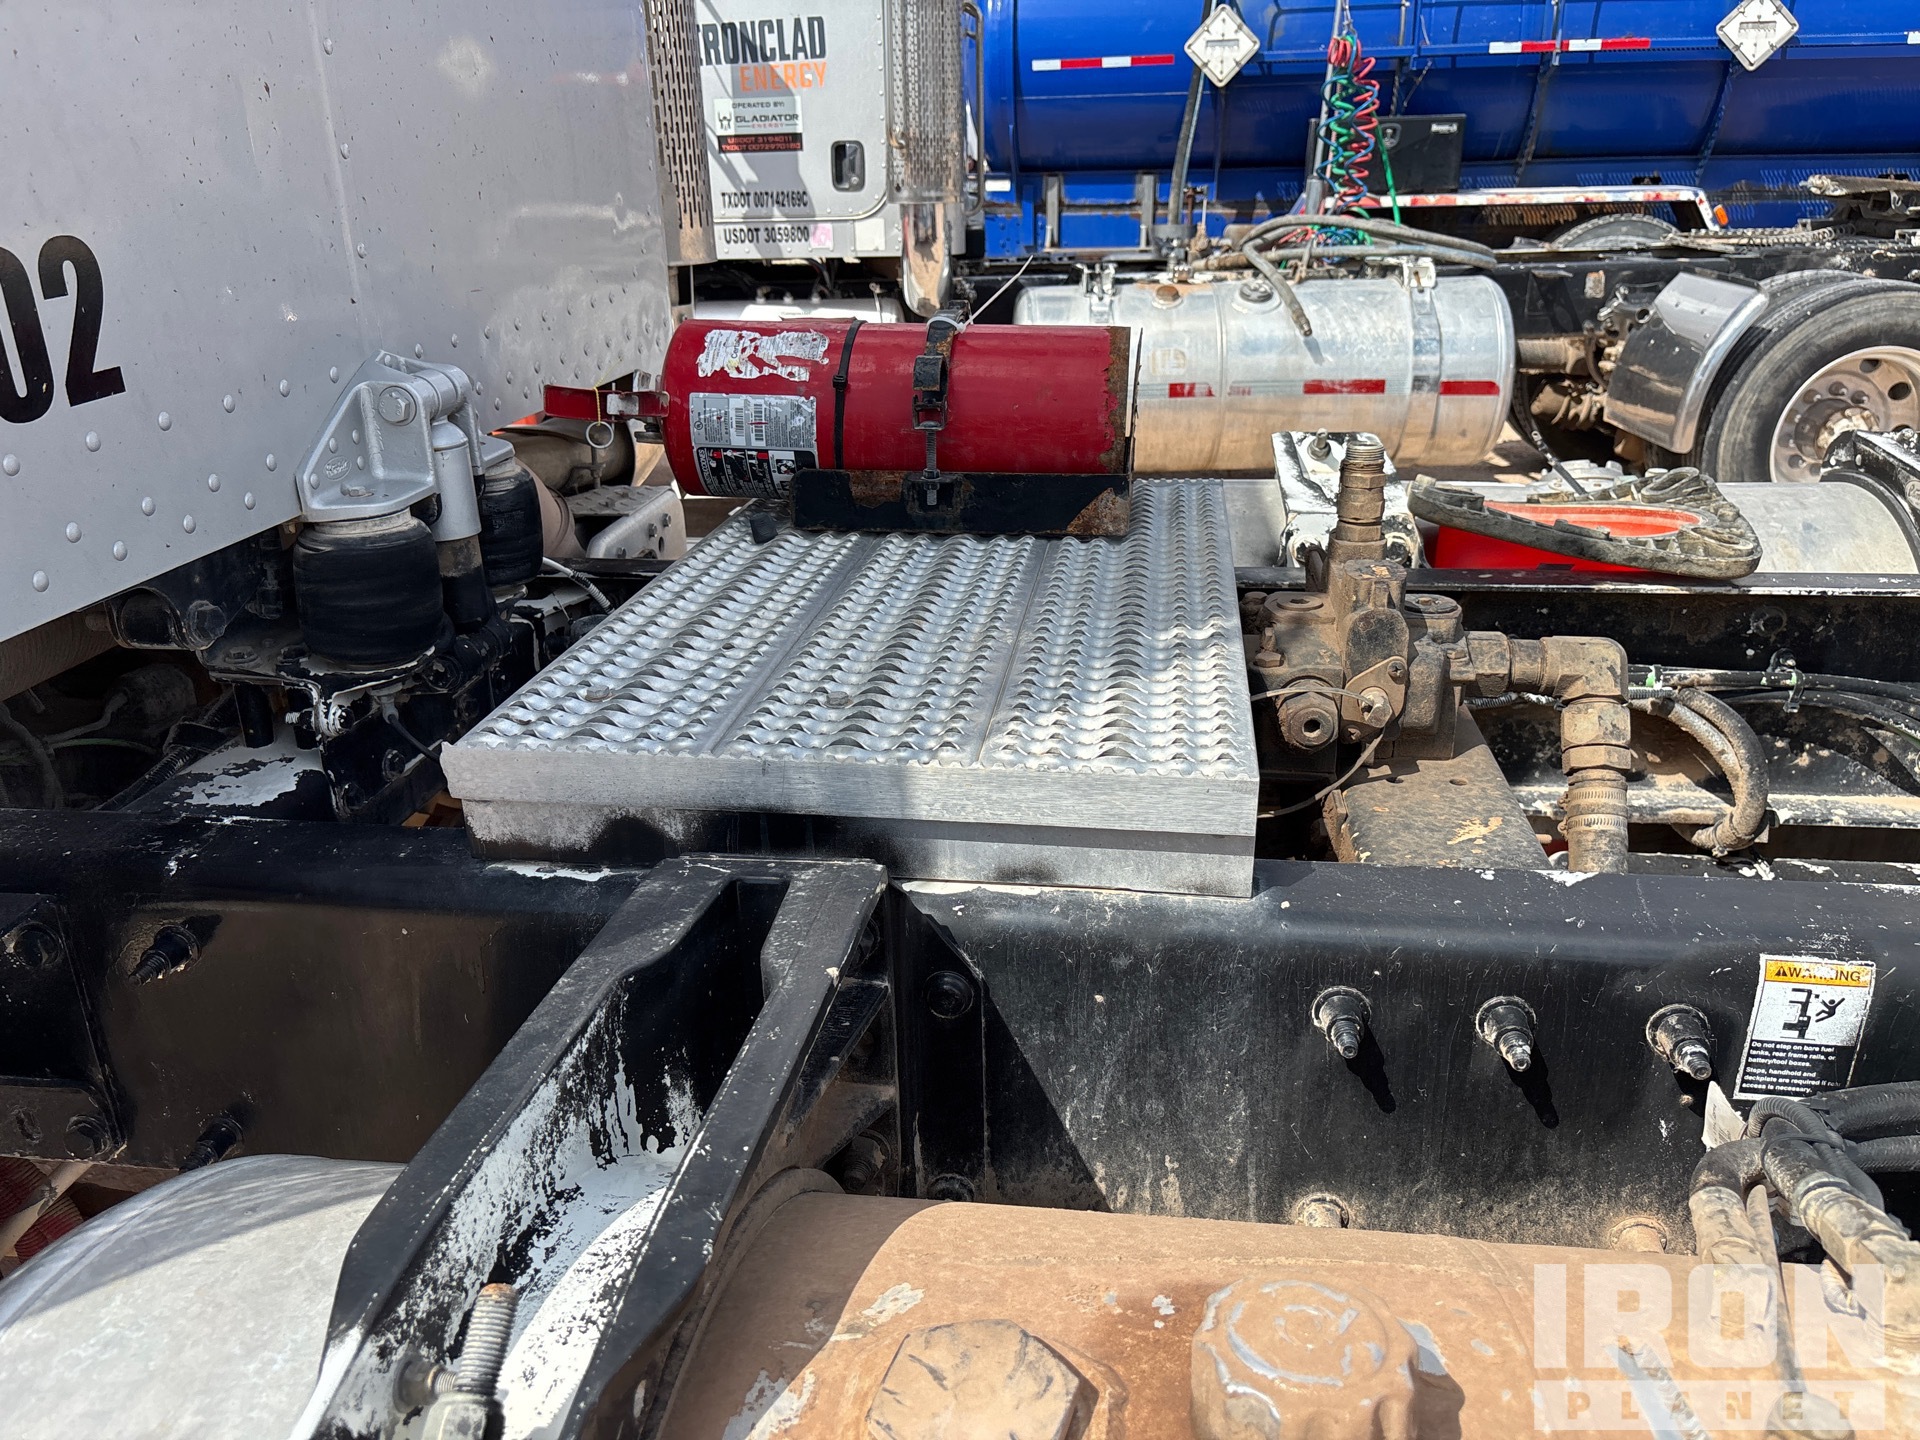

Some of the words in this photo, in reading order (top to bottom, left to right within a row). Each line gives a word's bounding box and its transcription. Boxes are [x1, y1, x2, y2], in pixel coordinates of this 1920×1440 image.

[740, 62, 827, 92] ENERGY
[735, 114, 799, 122] GLADIATOR
[721, 192, 752, 208] TXDOT
[723, 228, 761, 244] USDOT
[1750, 1049, 1770, 1057] tanks,
[1769, 1069, 1801, 1077] handhold
[1744, 1075, 1777, 1083] deckplate
[1791, 1078, 1820, 1086] required
[1775, 1085, 1812, 1093] necessary.
